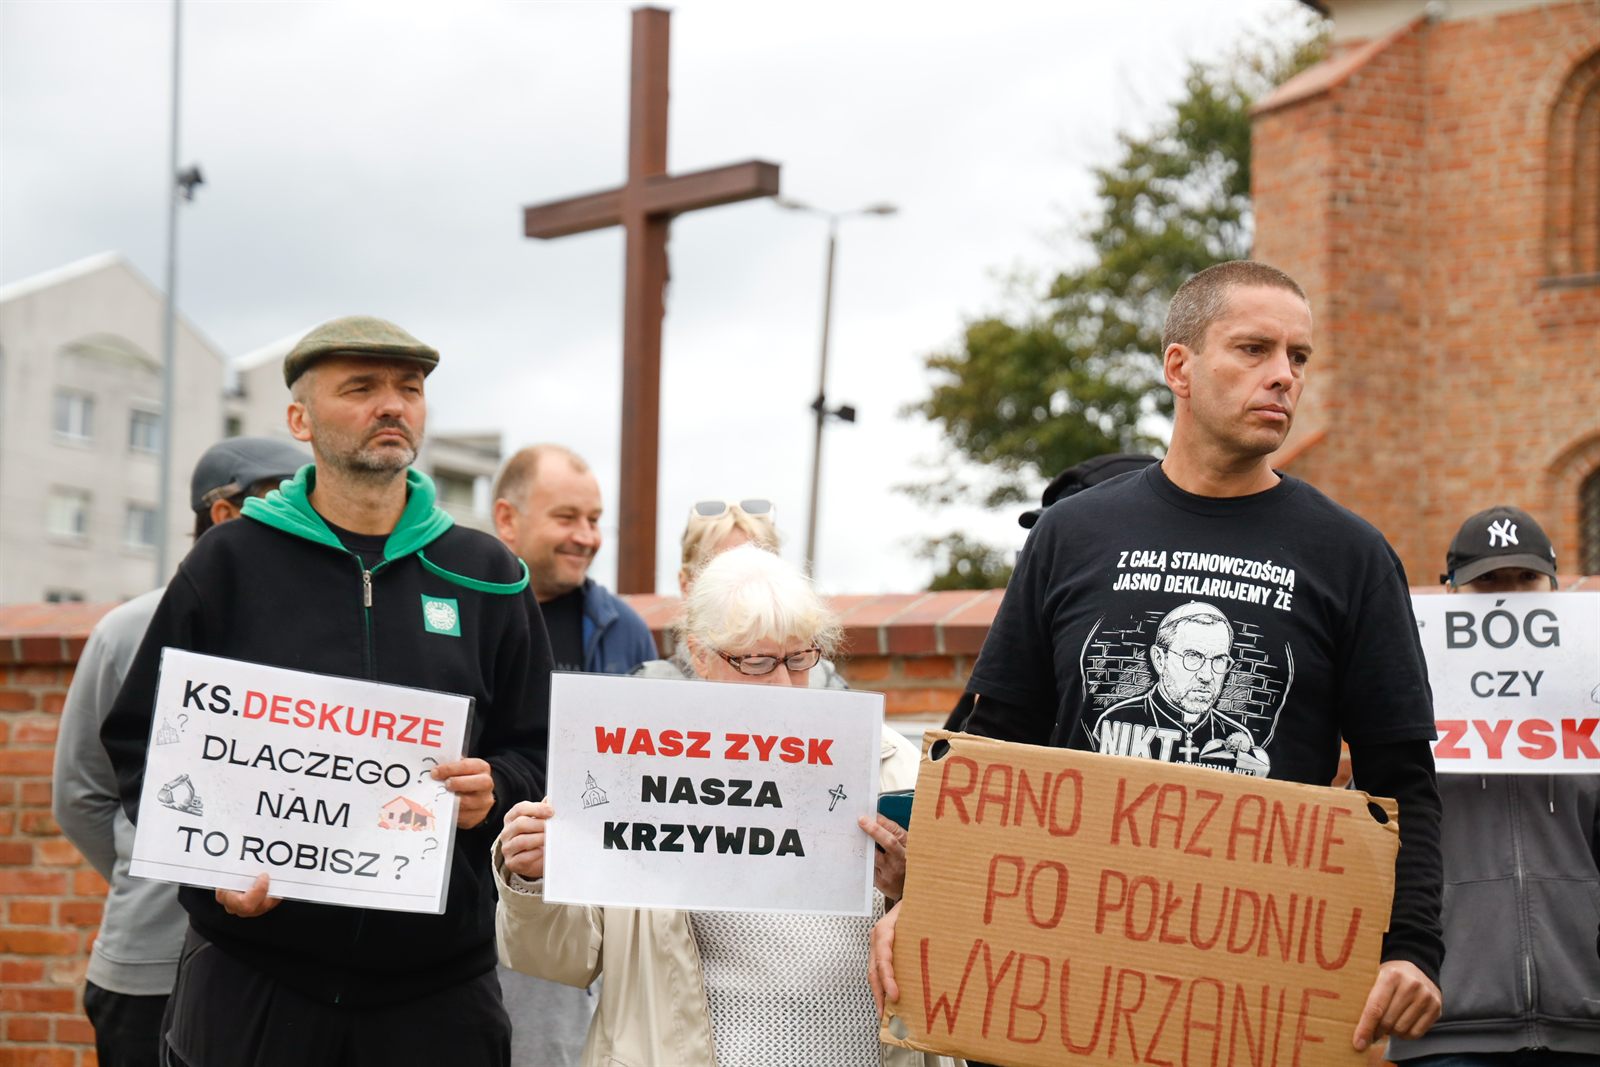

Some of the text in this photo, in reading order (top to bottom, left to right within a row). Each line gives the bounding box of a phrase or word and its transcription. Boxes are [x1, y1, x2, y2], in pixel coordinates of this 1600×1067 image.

[1112, 573, 1294, 612] JASNO DEKLARUJEMY ŻE
[1116, 550, 1296, 592] Z CAŁĄ STANOWCZOŚCIĄ
[1445, 599, 1560, 649] BÓG
[1470, 670, 1544, 698] CZY
[595, 726, 834, 766] WASZ ZYSK
[1100, 719, 1182, 763] NIKT
[1433, 717, 1600, 760] ZYSK
[201, 734, 411, 789] DLACZEGO
[255, 790, 351, 828] NAM
[640, 774, 783, 809] NASZA
[935, 756, 1352, 875] RANO KAZANIE
[177, 825, 410, 881] TO ROBISZ ?
[603, 821, 806, 858] KRZYWDA
[983, 854, 1362, 971] PO POŁUDNIU
[919, 937, 1341, 1067] WYBURZANIE
